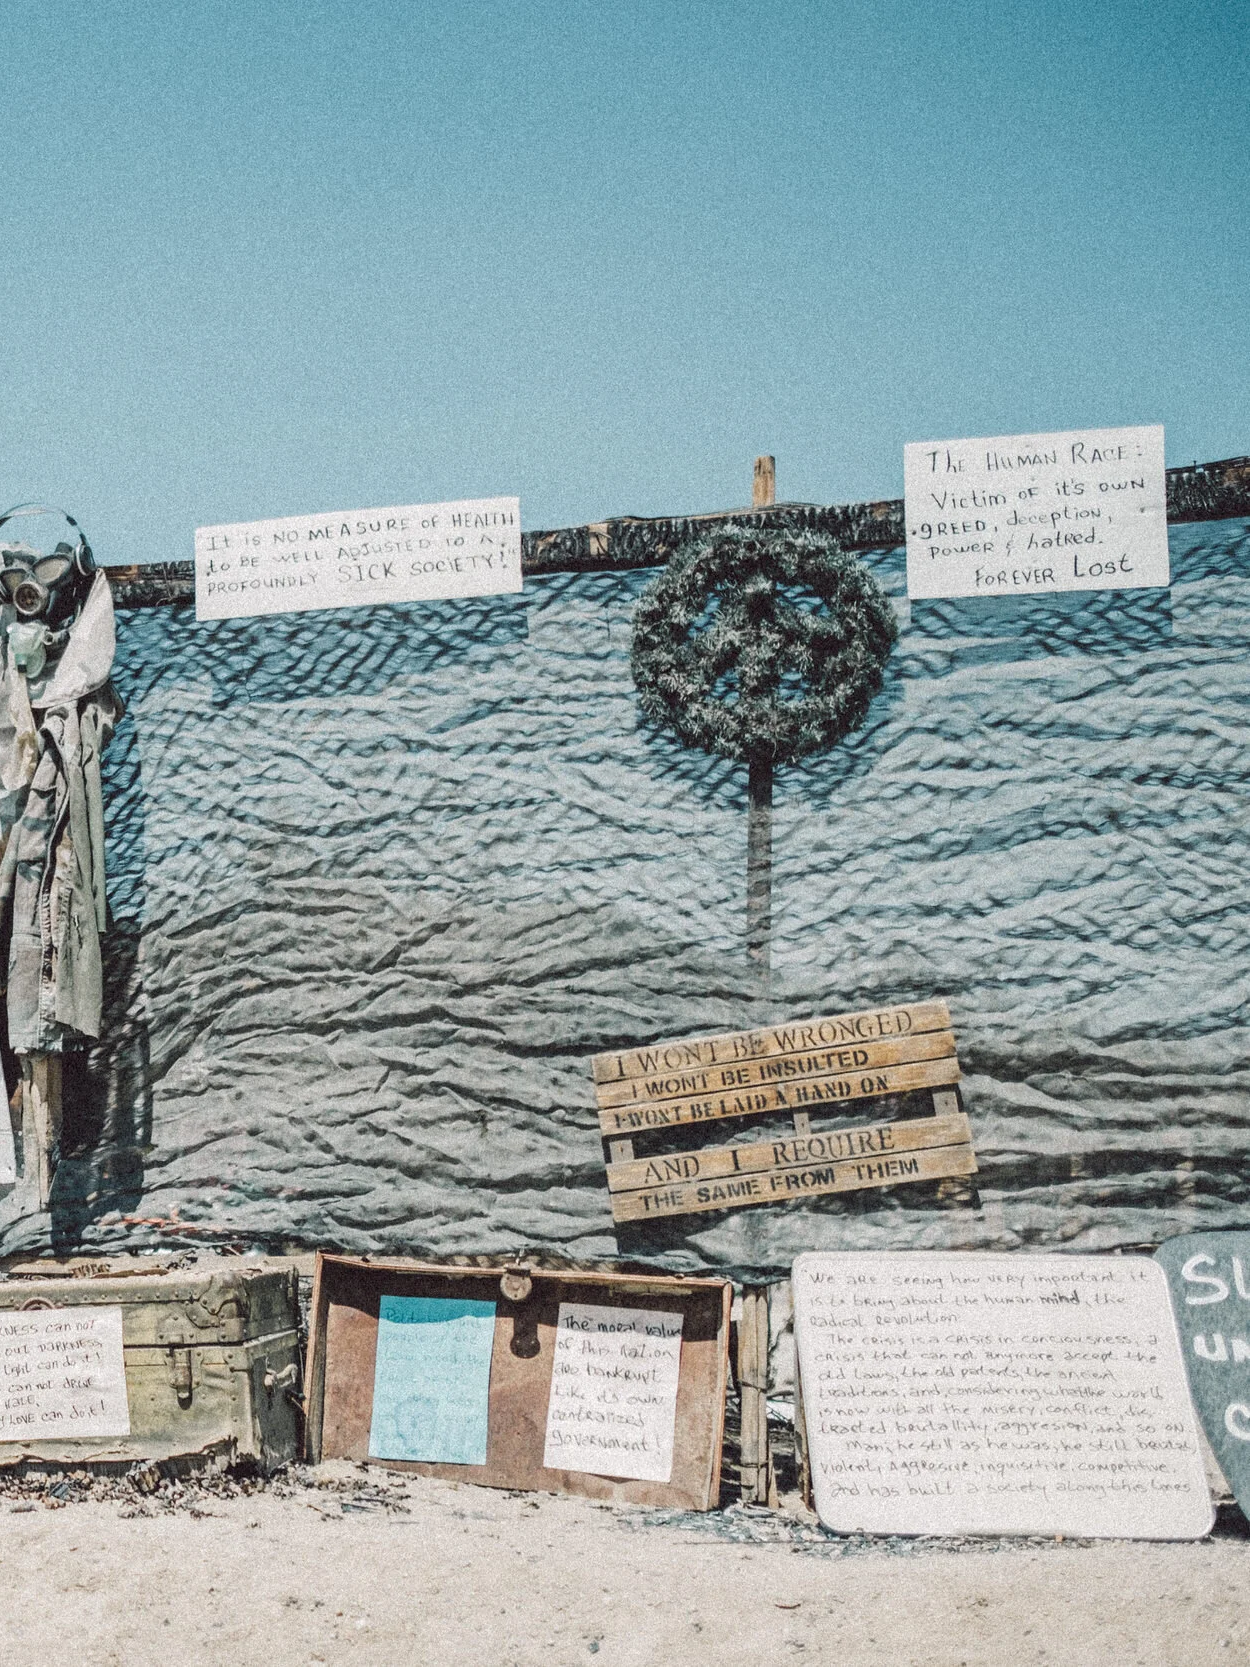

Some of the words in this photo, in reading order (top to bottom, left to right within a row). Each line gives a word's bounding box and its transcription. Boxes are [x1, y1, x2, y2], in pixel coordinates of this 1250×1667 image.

[987, 452, 1057, 470] HUMAN
[932, 491, 1006, 510] Victim
[1055, 479, 1084, 496] it's
[274, 531, 298, 544] NO
[309, 518, 407, 540] MEASURE
[453, 512, 514, 527] HEALTH
[208, 573, 318, 596] PROFOUNDLY
[337, 562, 397, 583] SICK
[410, 552, 508, 575] SOCIETY!
[240, 556, 259, 568] BE
[274, 550, 323, 564] WELL
[337, 538, 430, 560] ADJUSTED
[1074, 553, 1134, 578] Lost
[615, 1055, 626, 1077] I
[638, 1040, 718, 1071] WONT
[734, 1034, 765, 1057] BE
[773, 1011, 912, 1051] WRONGED
[632, 1083, 638, 1098] I
[647, 1072, 708, 1093] WONT
[721, 1068, 751, 1085] BE
[759, 1050, 868, 1079] INSULTED
[690, 1102, 713, 1119] BE
[720, 1093, 767, 1115] LAID
[775, 1088, 787, 1106] A
[796, 1082, 850, 1102] HAND
[862, 1074, 888, 1093] ON
[644, 1155, 699, 1184] AND
[731, 1150, 741, 1171] I
[773, 1127, 895, 1164] REQUIRE
[638, 1189, 683, 1212] THE
[698, 1179, 761, 1202] SAME
[771, 1166, 835, 1194] FROM
[851, 1158, 919, 1182] THEM
